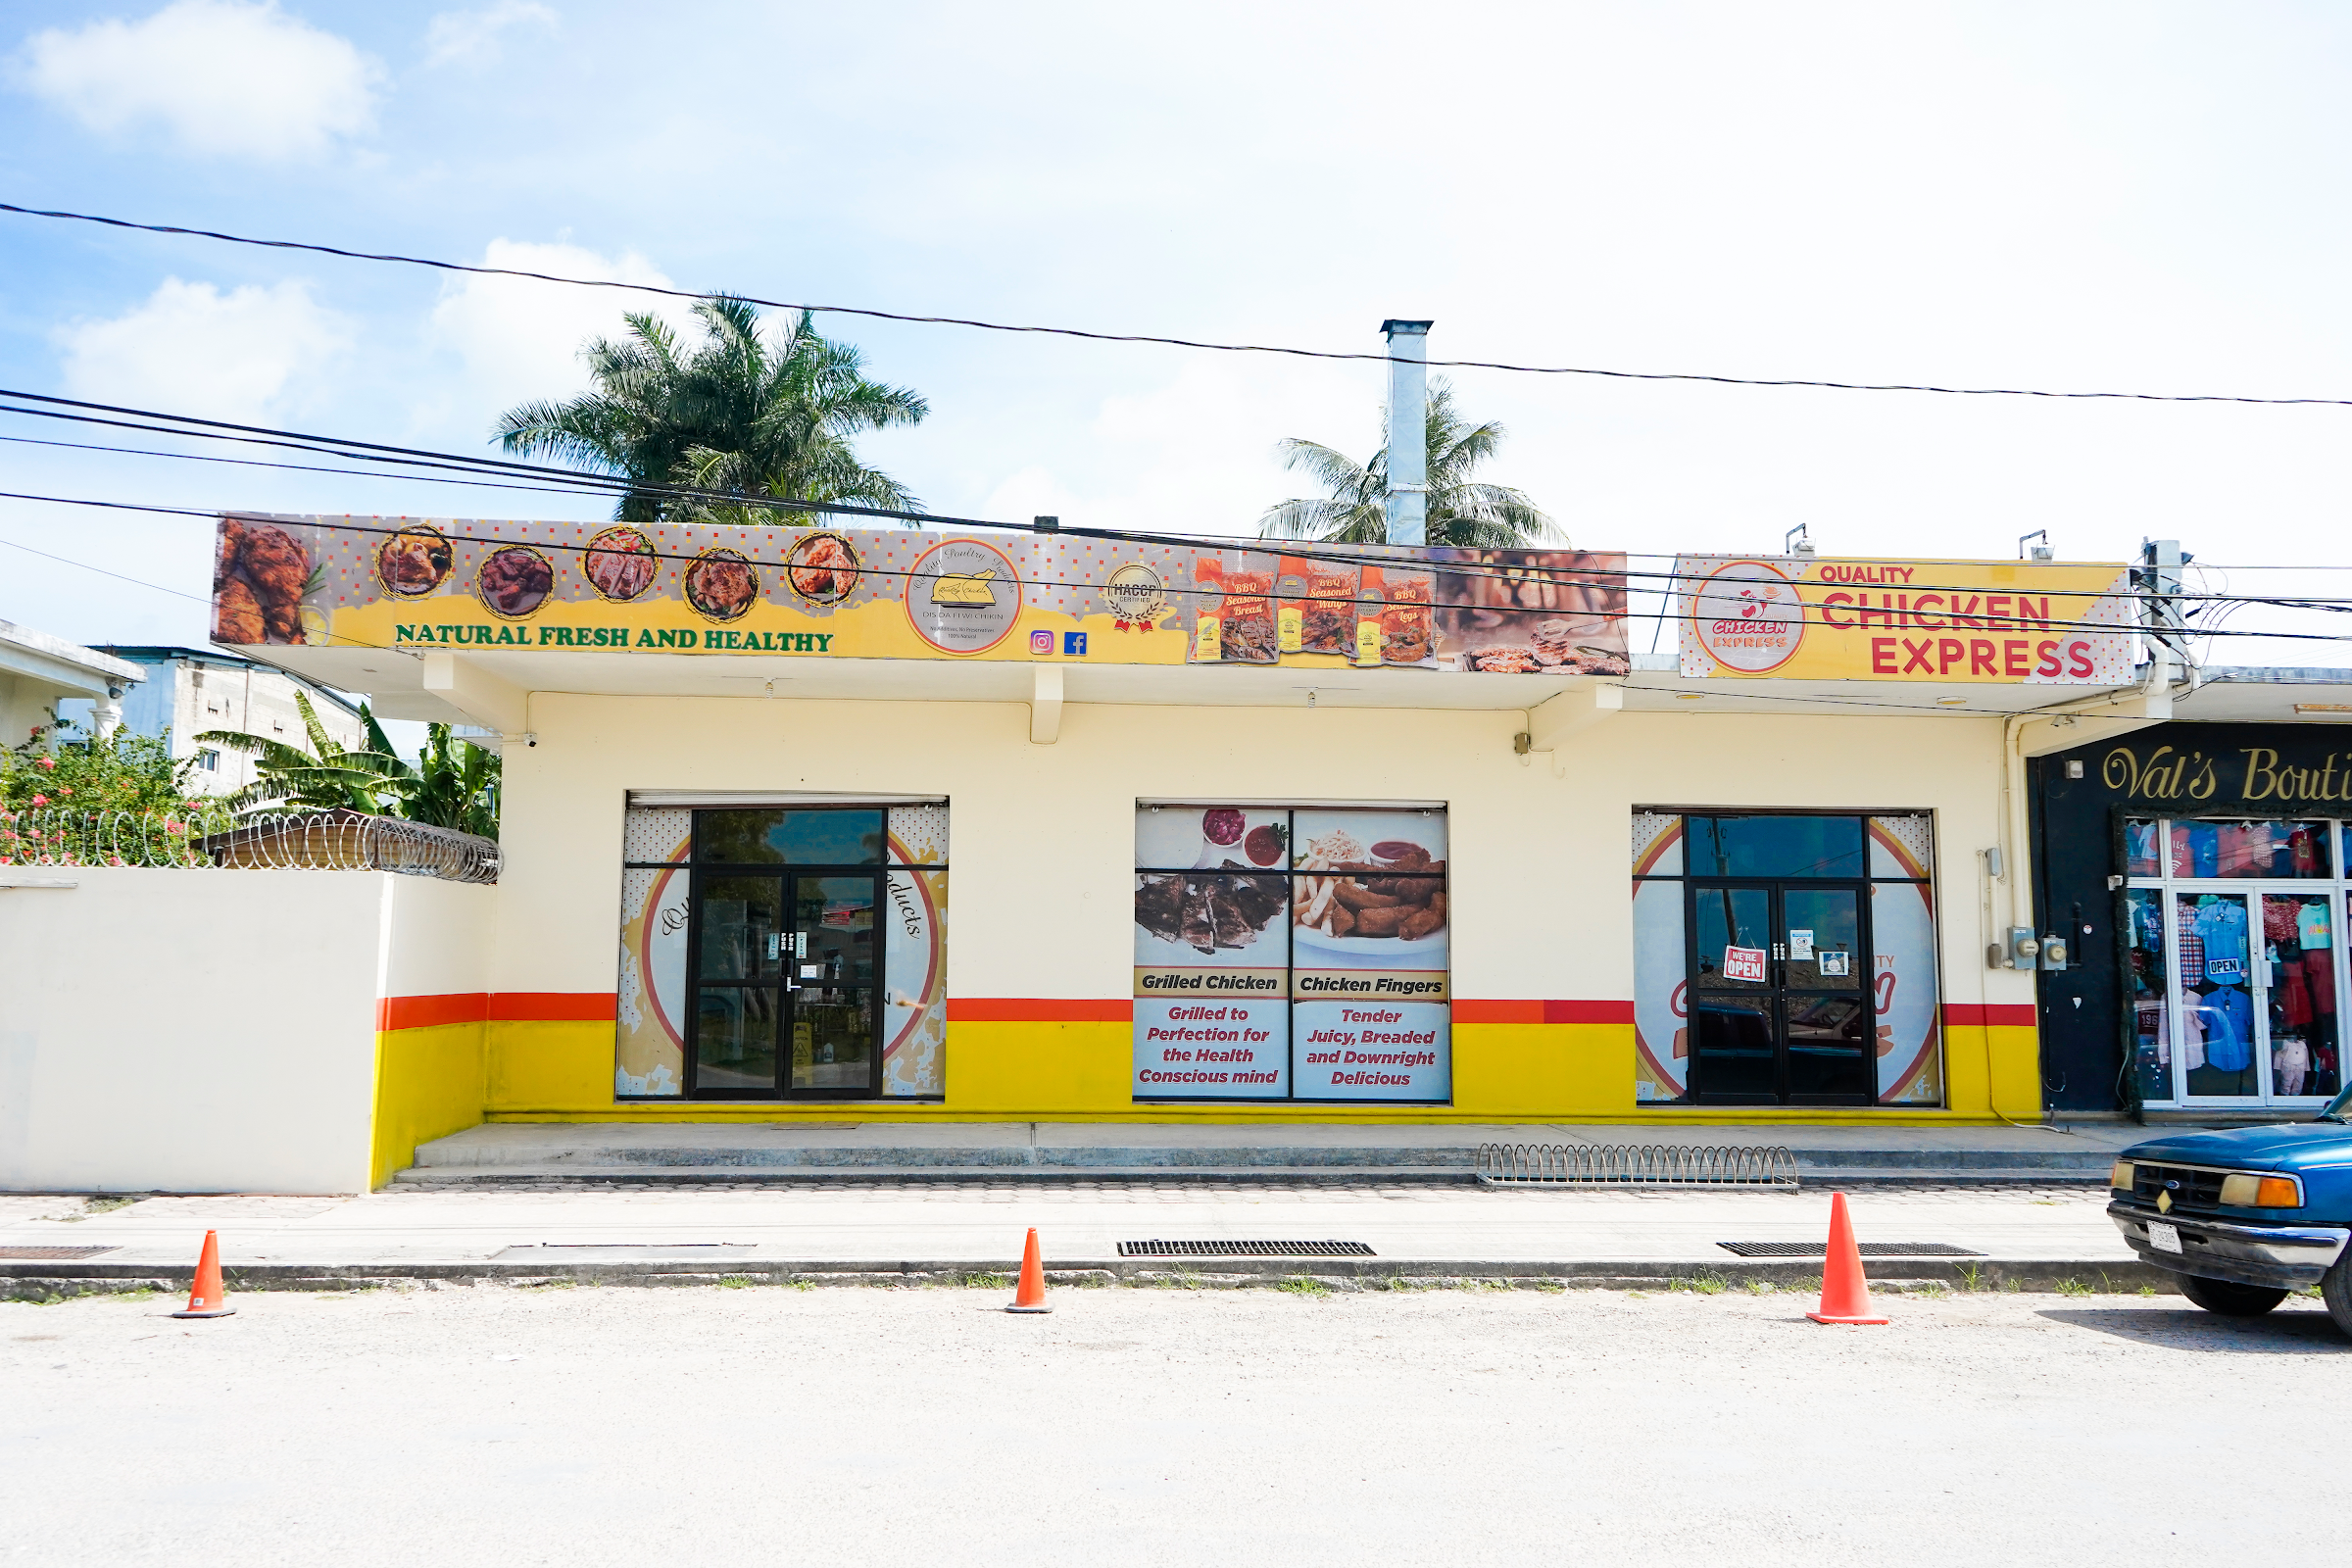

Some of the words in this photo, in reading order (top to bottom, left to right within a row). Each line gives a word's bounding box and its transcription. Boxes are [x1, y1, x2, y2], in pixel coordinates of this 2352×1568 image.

[944, 548, 987, 562] Poultry
[1820, 565, 1914, 583] QUALITY
[1114, 583, 1156, 597] HACCP
[1234, 582, 1257, 593] BBQ
[1318, 578, 1342, 587] BBQ
[1309, 586, 1352, 598] Seasoned
[1394, 589, 1417, 600] BBQ
[1233, 604, 1264, 616] Breast
[1316, 599, 1348, 610] Wings
[1398, 612, 1418, 623] Legs
[1822, 592, 2049, 633] CHICKEN
[1712, 619, 1788, 634] CHICKEN
[395, 624, 532, 644] NATURAL
[538, 626, 630, 646] FRESH
[635, 628, 698, 648] AND
[704, 630, 833, 652] HEALTHY
[1713, 636, 1788, 648] EXPRESS
[1871, 637, 2094, 678] EXPRESS
[2103, 745, 2217, 800] Val's
[2239, 748, 2352, 801] Bouti
[1732, 951, 1757, 961] WE'RE
[1727, 959, 1761, 977] OPEN
[2210, 959, 2238, 973] OPEN
[1142, 974, 1202, 989] Grilled
[1205, 975, 1278, 990] Chicken
[1299, 977, 1371, 992] Chicken
[1375, 978, 1443, 994] Fingers
[1168, 1006, 1227, 1021] Grilled
[1230, 1008, 1249, 1021] to
[1342, 1009, 1402, 1023] Tender
[1147, 1027, 1241, 1042] Perfection
[1243, 1028, 1270, 1042] for
[1306, 1029, 1355, 1046] Juicy,
[1360, 1030, 1436, 1045] Breaded
[1163, 1048, 1194, 1061] the
[1196, 1049, 1253, 1063] Health
[1306, 1050, 1341, 1064] and
[1344, 1051, 1436, 1066] Downright
[1139, 1069, 1229, 1083] Conscious
[1232, 1069, 1278, 1084] mind
[1331, 1071, 1410, 1086] Delicious
